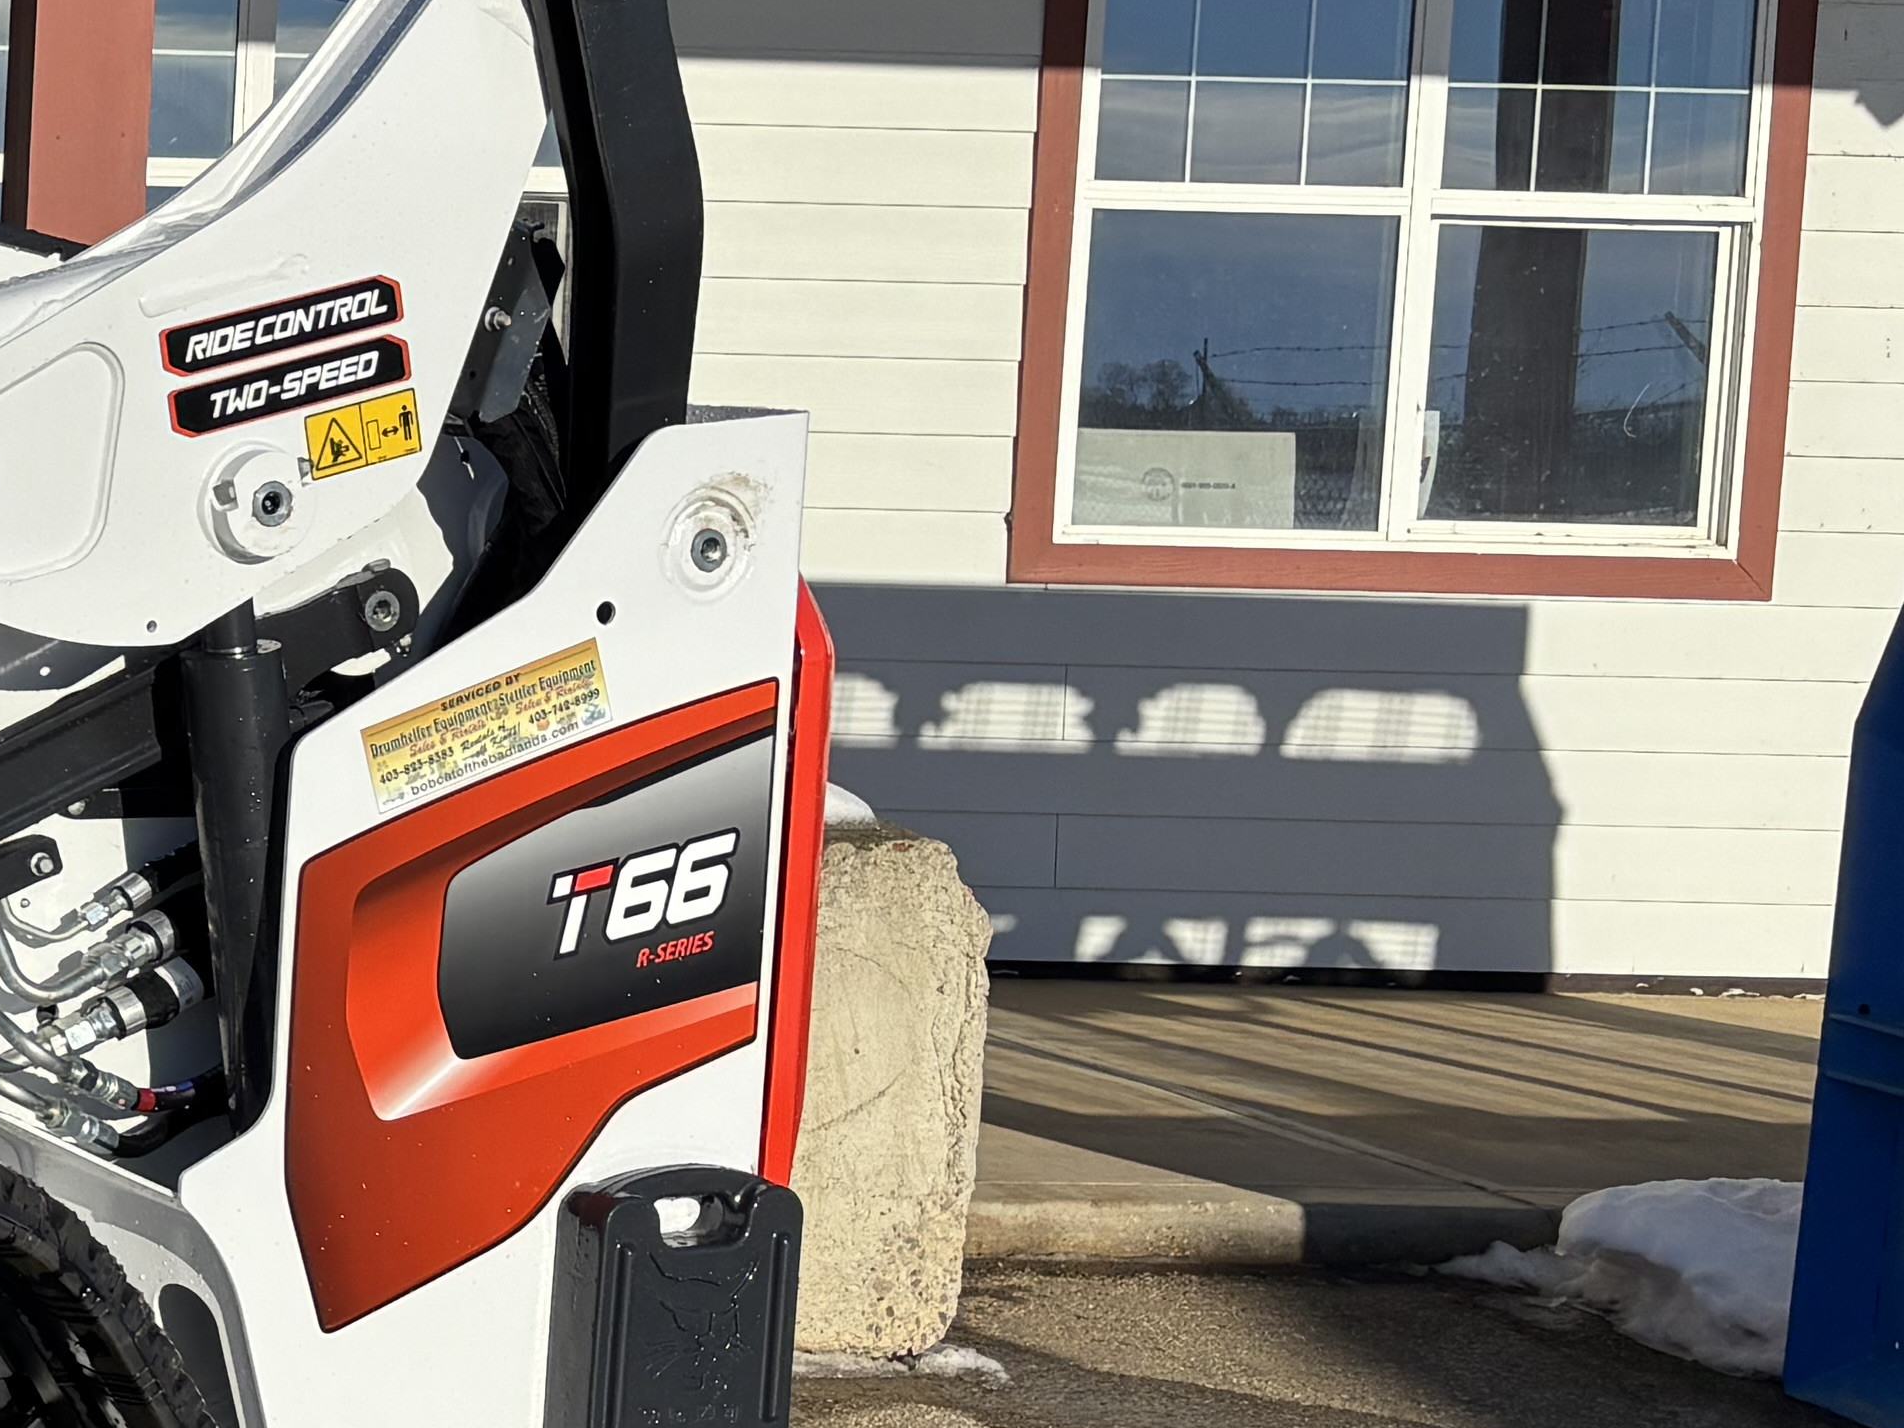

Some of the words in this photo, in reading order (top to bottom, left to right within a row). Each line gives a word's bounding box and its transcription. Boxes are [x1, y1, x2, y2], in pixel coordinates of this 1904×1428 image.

[210, 350, 380, 419] TWO-SPEED
[439, 679, 501, 712] SERVICED
[504, 671, 521, 686] BY
[497, 679, 537, 708] Stettler
[538, 656, 596, 694] Equipment
[527, 686, 600, 725] 403-742-8999
[370, 721, 433, 759] Drumheller
[432, 698, 491, 736] Equipment
[378, 745, 454, 785] 403-823-8383
[410, 718, 578, 796] bobcatofthebadlands.com
[551, 831, 738, 956] T66
[636, 931, 714, 968] R-SERIES
